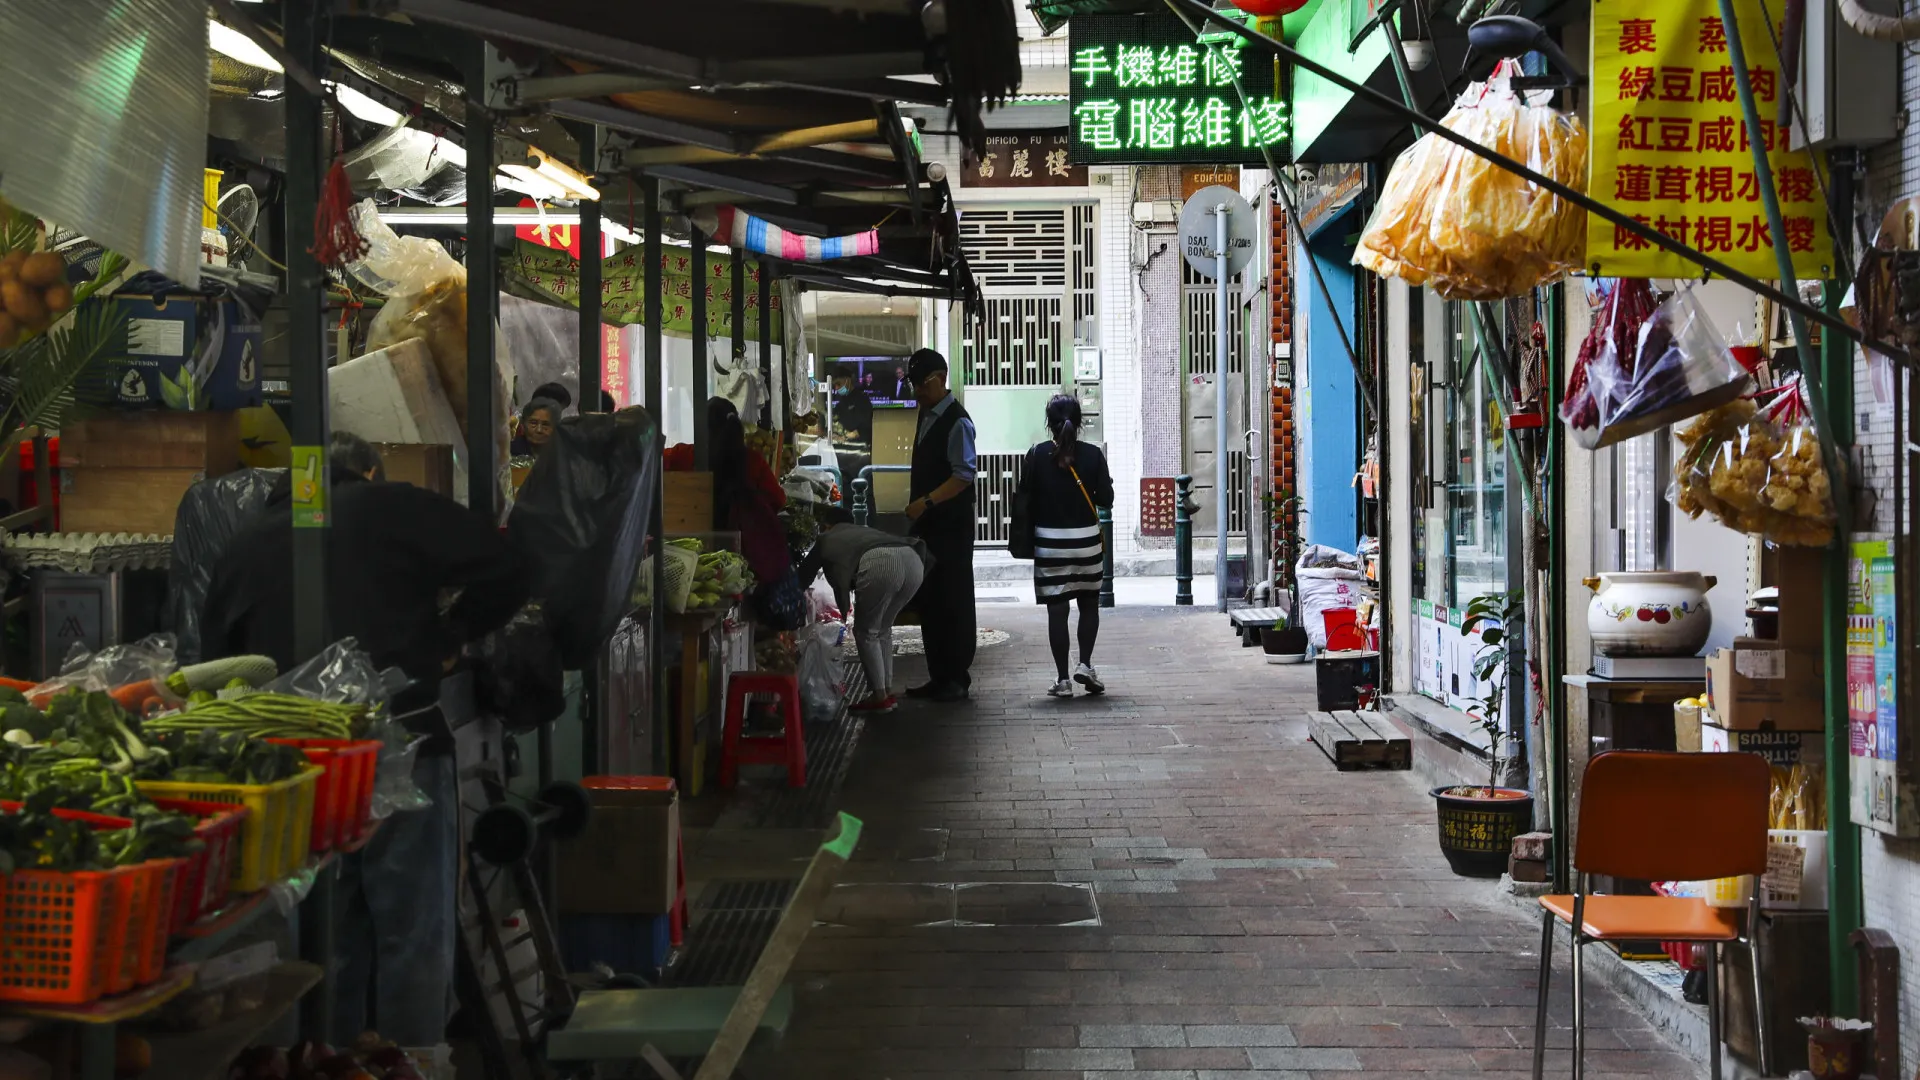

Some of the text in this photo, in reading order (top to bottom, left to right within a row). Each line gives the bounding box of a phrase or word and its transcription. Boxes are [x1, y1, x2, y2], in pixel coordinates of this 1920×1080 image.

[1072, 44, 1243, 88] 手機維修
[1073, 97, 1289, 149] 電腦維修
[986, 135, 1019, 145] DIFICIO
[1030, 135, 1042, 145] FU
[1097, 175, 1106, 184] 39
[1193, 172, 1233, 183] EDIFICIO
[1740, 733, 1800, 745] CITRUS
[1747, 749, 1800, 762] CITR
[1470, 823, 1487, 841] 福
